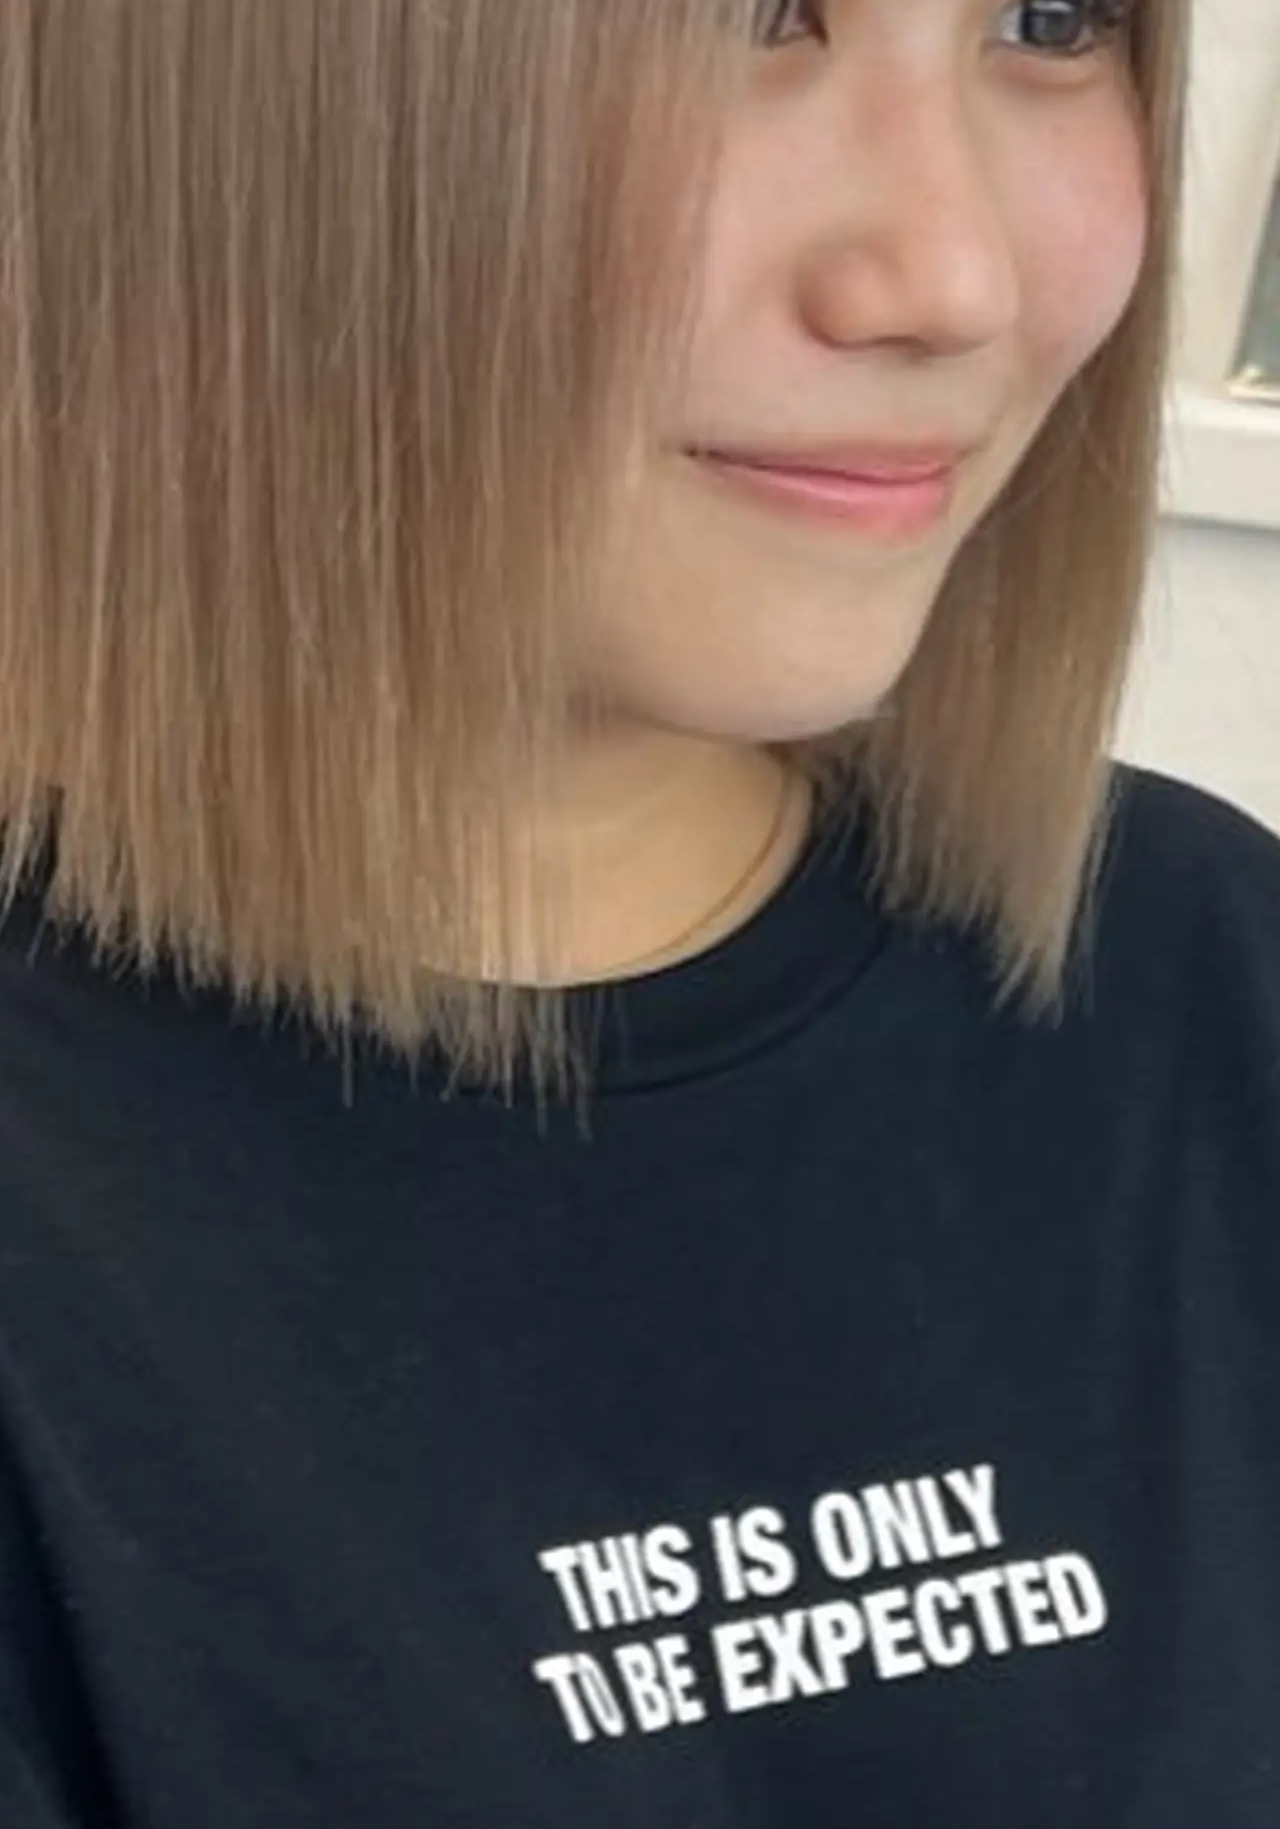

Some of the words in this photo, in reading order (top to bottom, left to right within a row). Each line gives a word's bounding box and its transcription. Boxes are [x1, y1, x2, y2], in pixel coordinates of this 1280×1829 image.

[538, 1525, 699, 1631] THIS
[711, 1507, 796, 1601] IS
[812, 1464, 1003, 1580] ONLY
[534, 1653, 626, 1743] TO
[614, 1635, 707, 1733] BE
[711, 1552, 1108, 1713] EXPECTED
